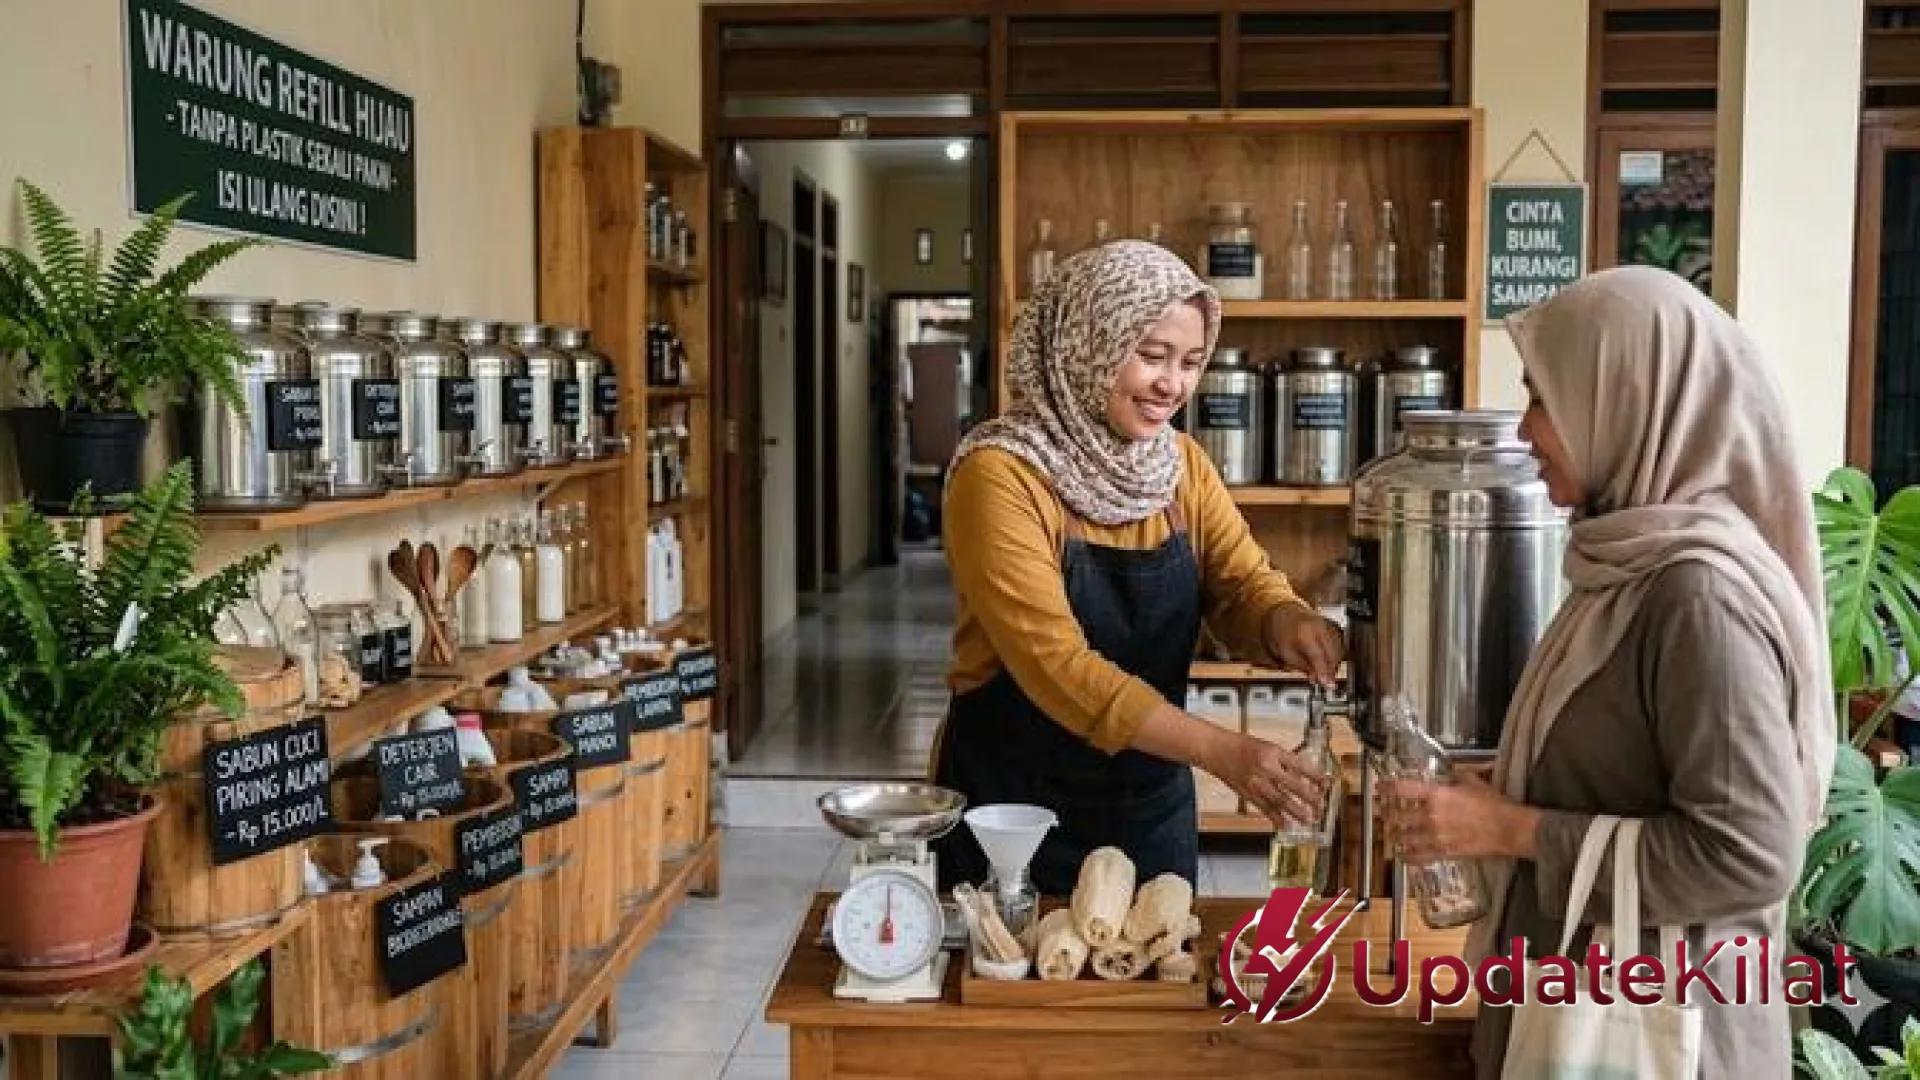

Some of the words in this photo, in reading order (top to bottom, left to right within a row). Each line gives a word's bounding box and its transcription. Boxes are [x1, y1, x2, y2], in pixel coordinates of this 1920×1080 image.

[140, 8, 272, 108] WARUNG
[277, 62, 351, 134] REFILL
[177, 100, 238, 148] TANPA
[219, 168, 243, 211] ISI
[248, 175, 308, 226] ULANG
[1505, 200, 1564, 223] CINTA
[1505, 228, 1563, 253] BUMI,
[1491, 256, 1576, 277] KURANGI
[216, 740, 278, 779] SABUN
[285, 730, 320, 761] CUCI
[216, 773, 280, 815] PIRING
[237, 820, 261, 847] Rp
